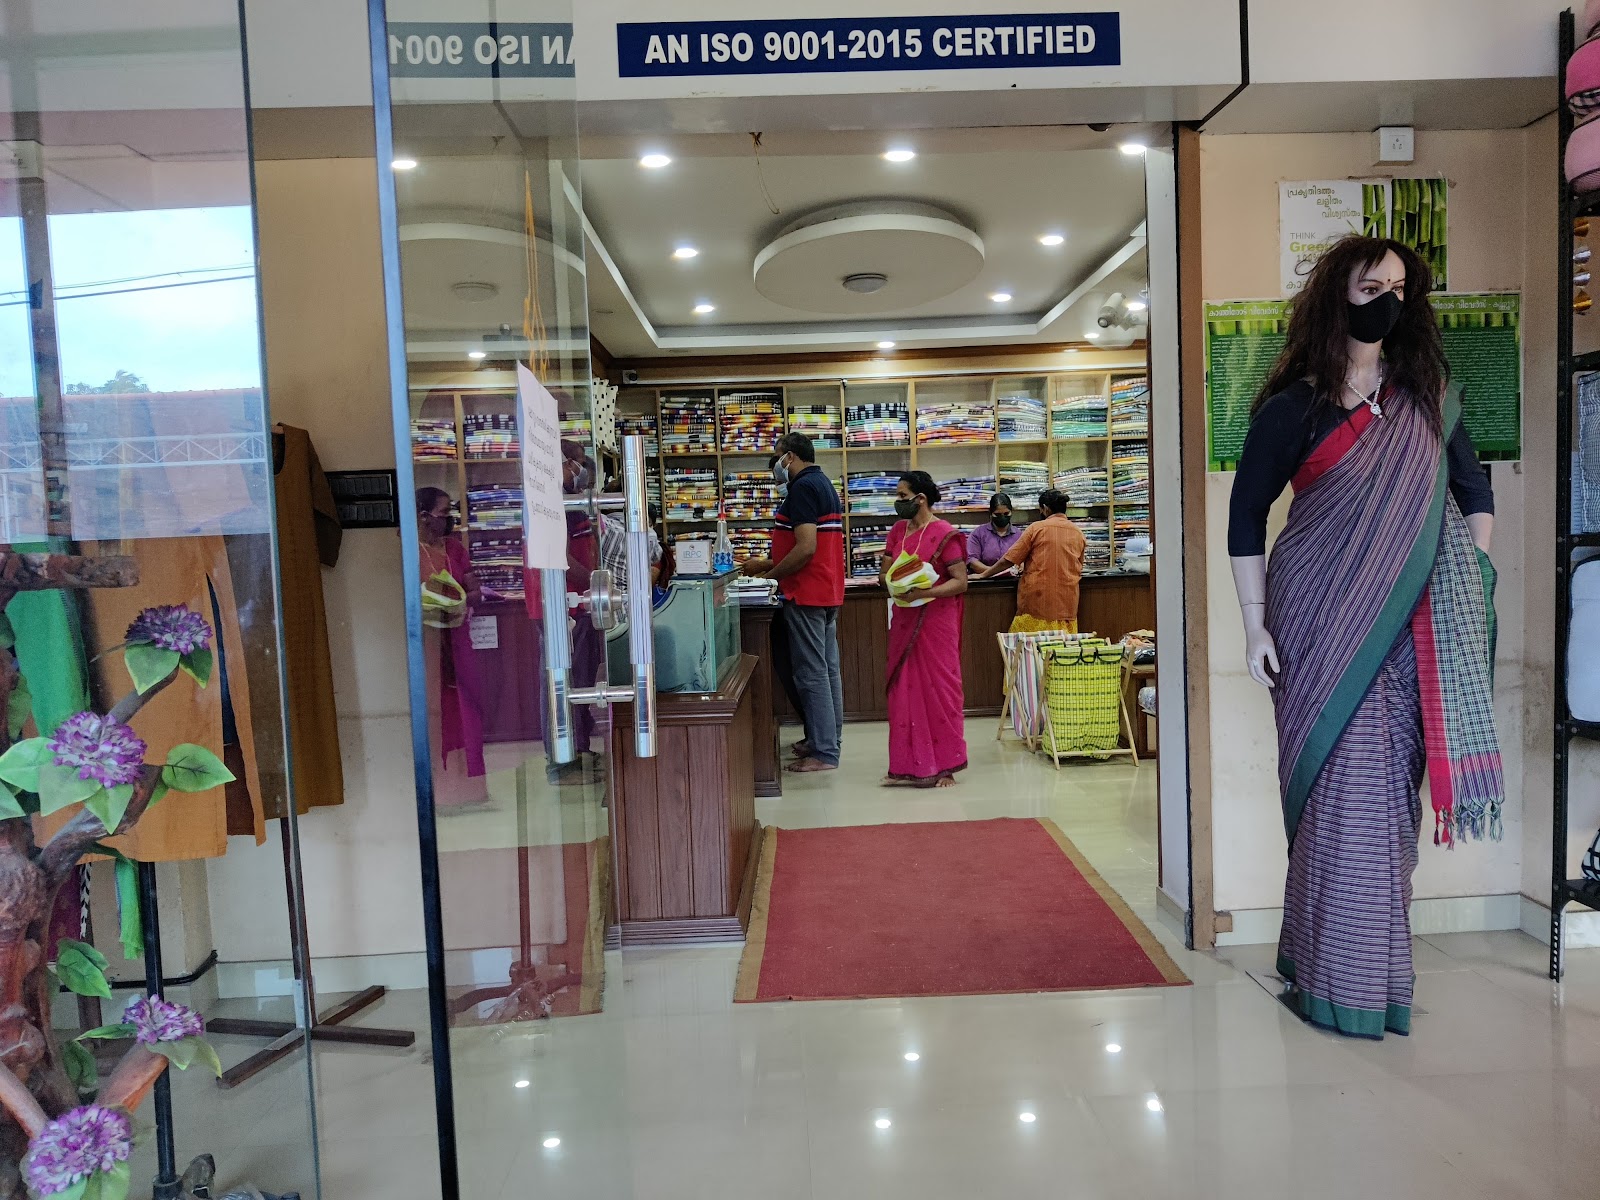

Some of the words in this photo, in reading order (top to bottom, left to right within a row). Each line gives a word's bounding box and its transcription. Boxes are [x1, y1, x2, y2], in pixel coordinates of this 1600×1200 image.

[644, 34, 689, 64] AN
[700, 32, 754, 63] ISO
[764, 28, 923, 62] 9001-2015
[932, 25, 1096, 57] CERTIFIED
[1317, 195, 1342, 207] ലളിതം
[1290, 232, 1316, 240] THINK
